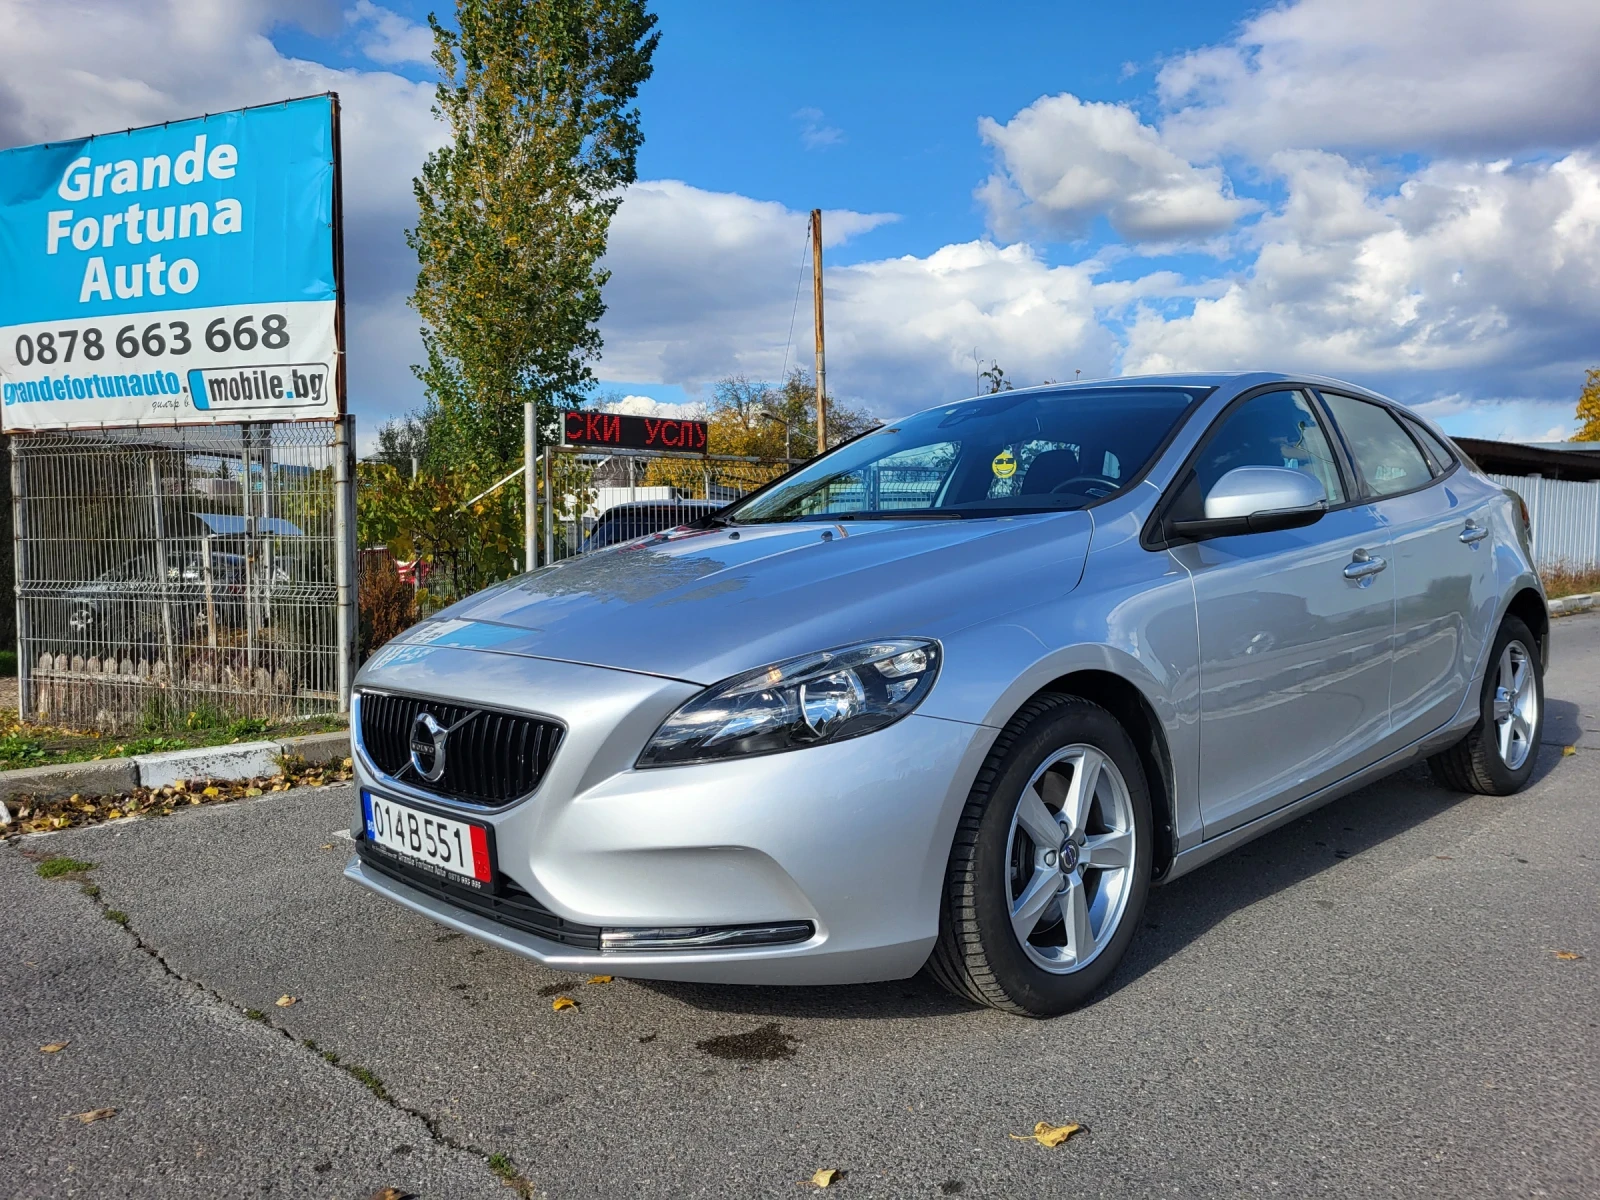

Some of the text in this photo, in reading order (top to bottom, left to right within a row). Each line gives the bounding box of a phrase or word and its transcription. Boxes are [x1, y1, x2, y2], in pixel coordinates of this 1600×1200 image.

[57, 133, 239, 202] Grande
[46, 198, 243, 255] Fortuna
[79, 252, 200, 303] Auto
[15, 314, 291, 366] 0878 663 668
[208, 369, 324, 401] mobile.bg
[566, 411, 621, 443] СКИ
[412, 743, 434, 753] VOLVO
